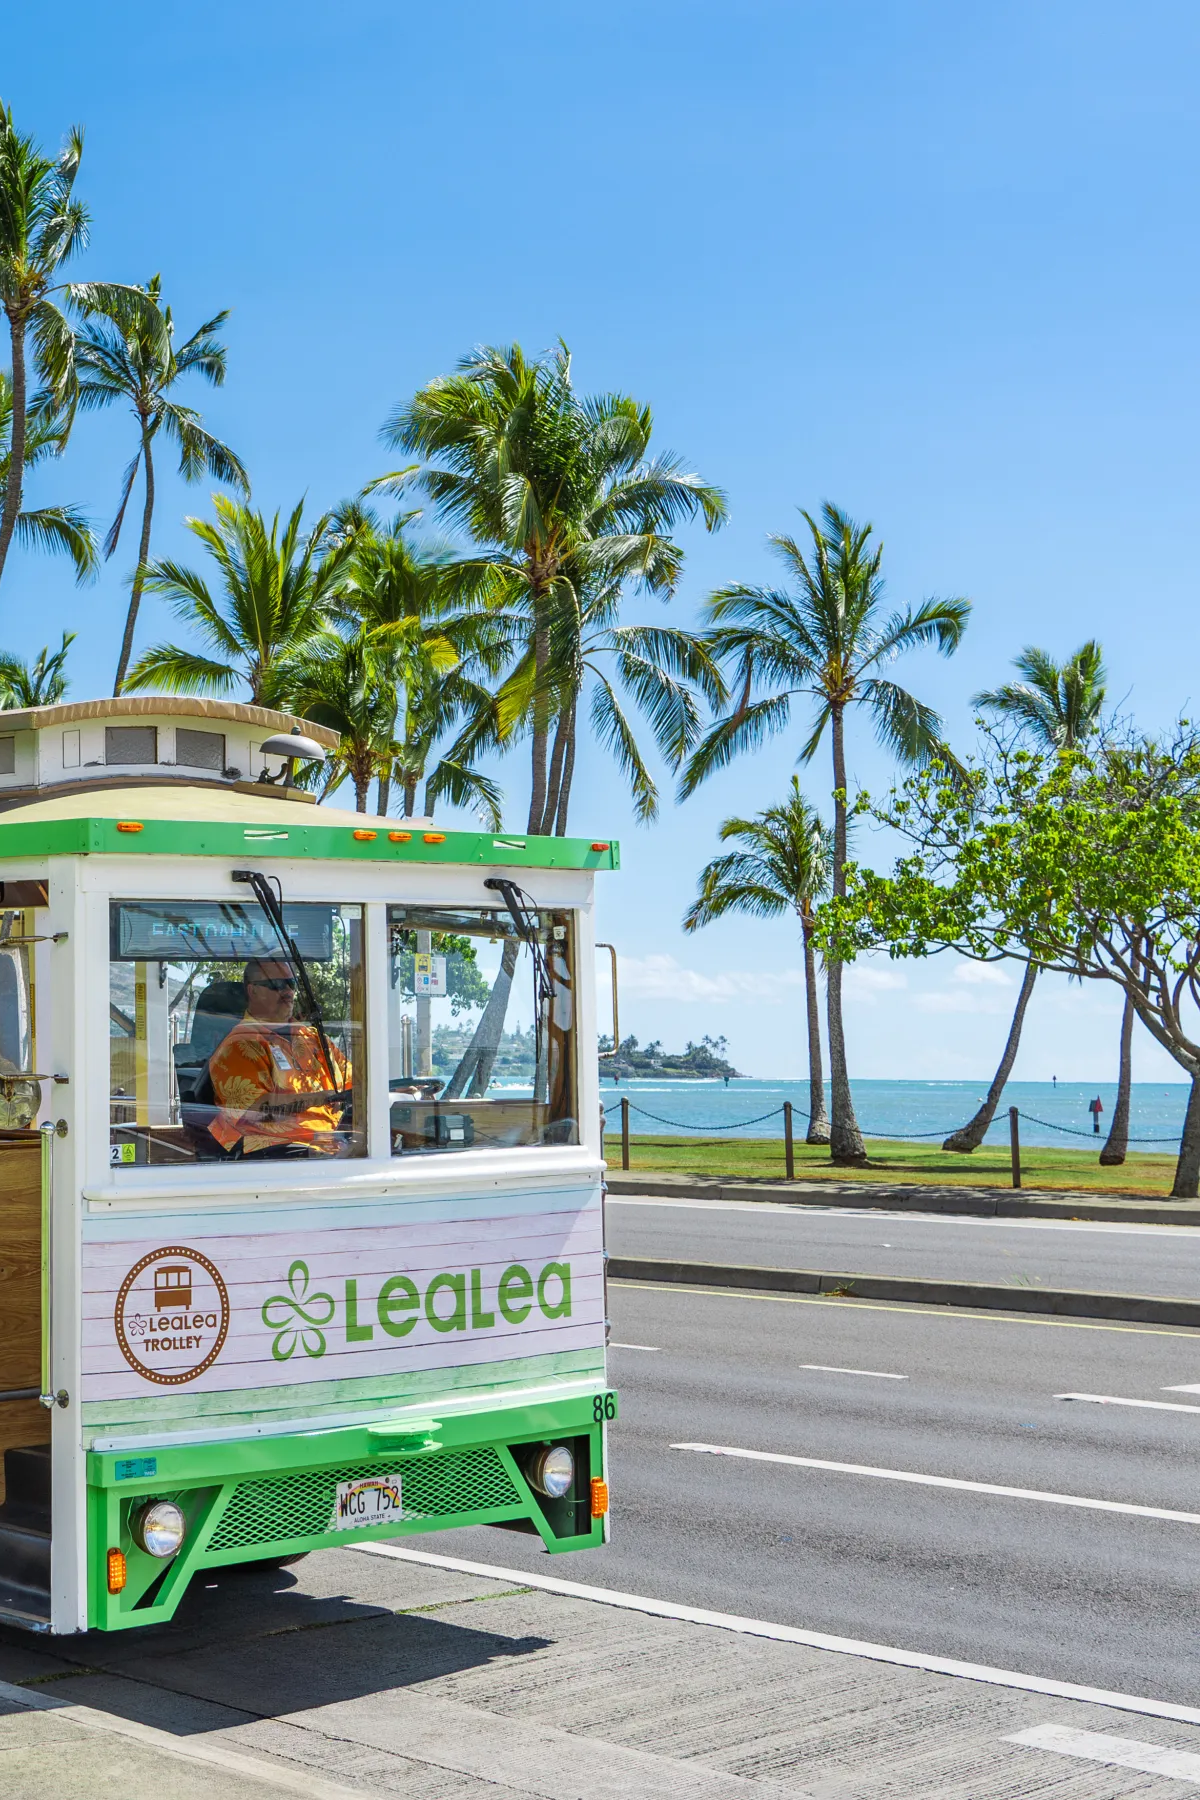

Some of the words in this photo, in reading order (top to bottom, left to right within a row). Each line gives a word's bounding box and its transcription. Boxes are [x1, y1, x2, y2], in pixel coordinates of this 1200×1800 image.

[111, 1148, 120, 1160] 2
[345, 1261, 572, 1343] LeaLea
[143, 1335, 203, 1352] TROLLEY
[592, 1392, 616, 1423] 86
[340, 1489, 366, 1518] WCG
[373, 1485, 400, 1512] 752
[353, 1515, 370, 1523] ALOHA
[370, 1513, 386, 1521] STATE
